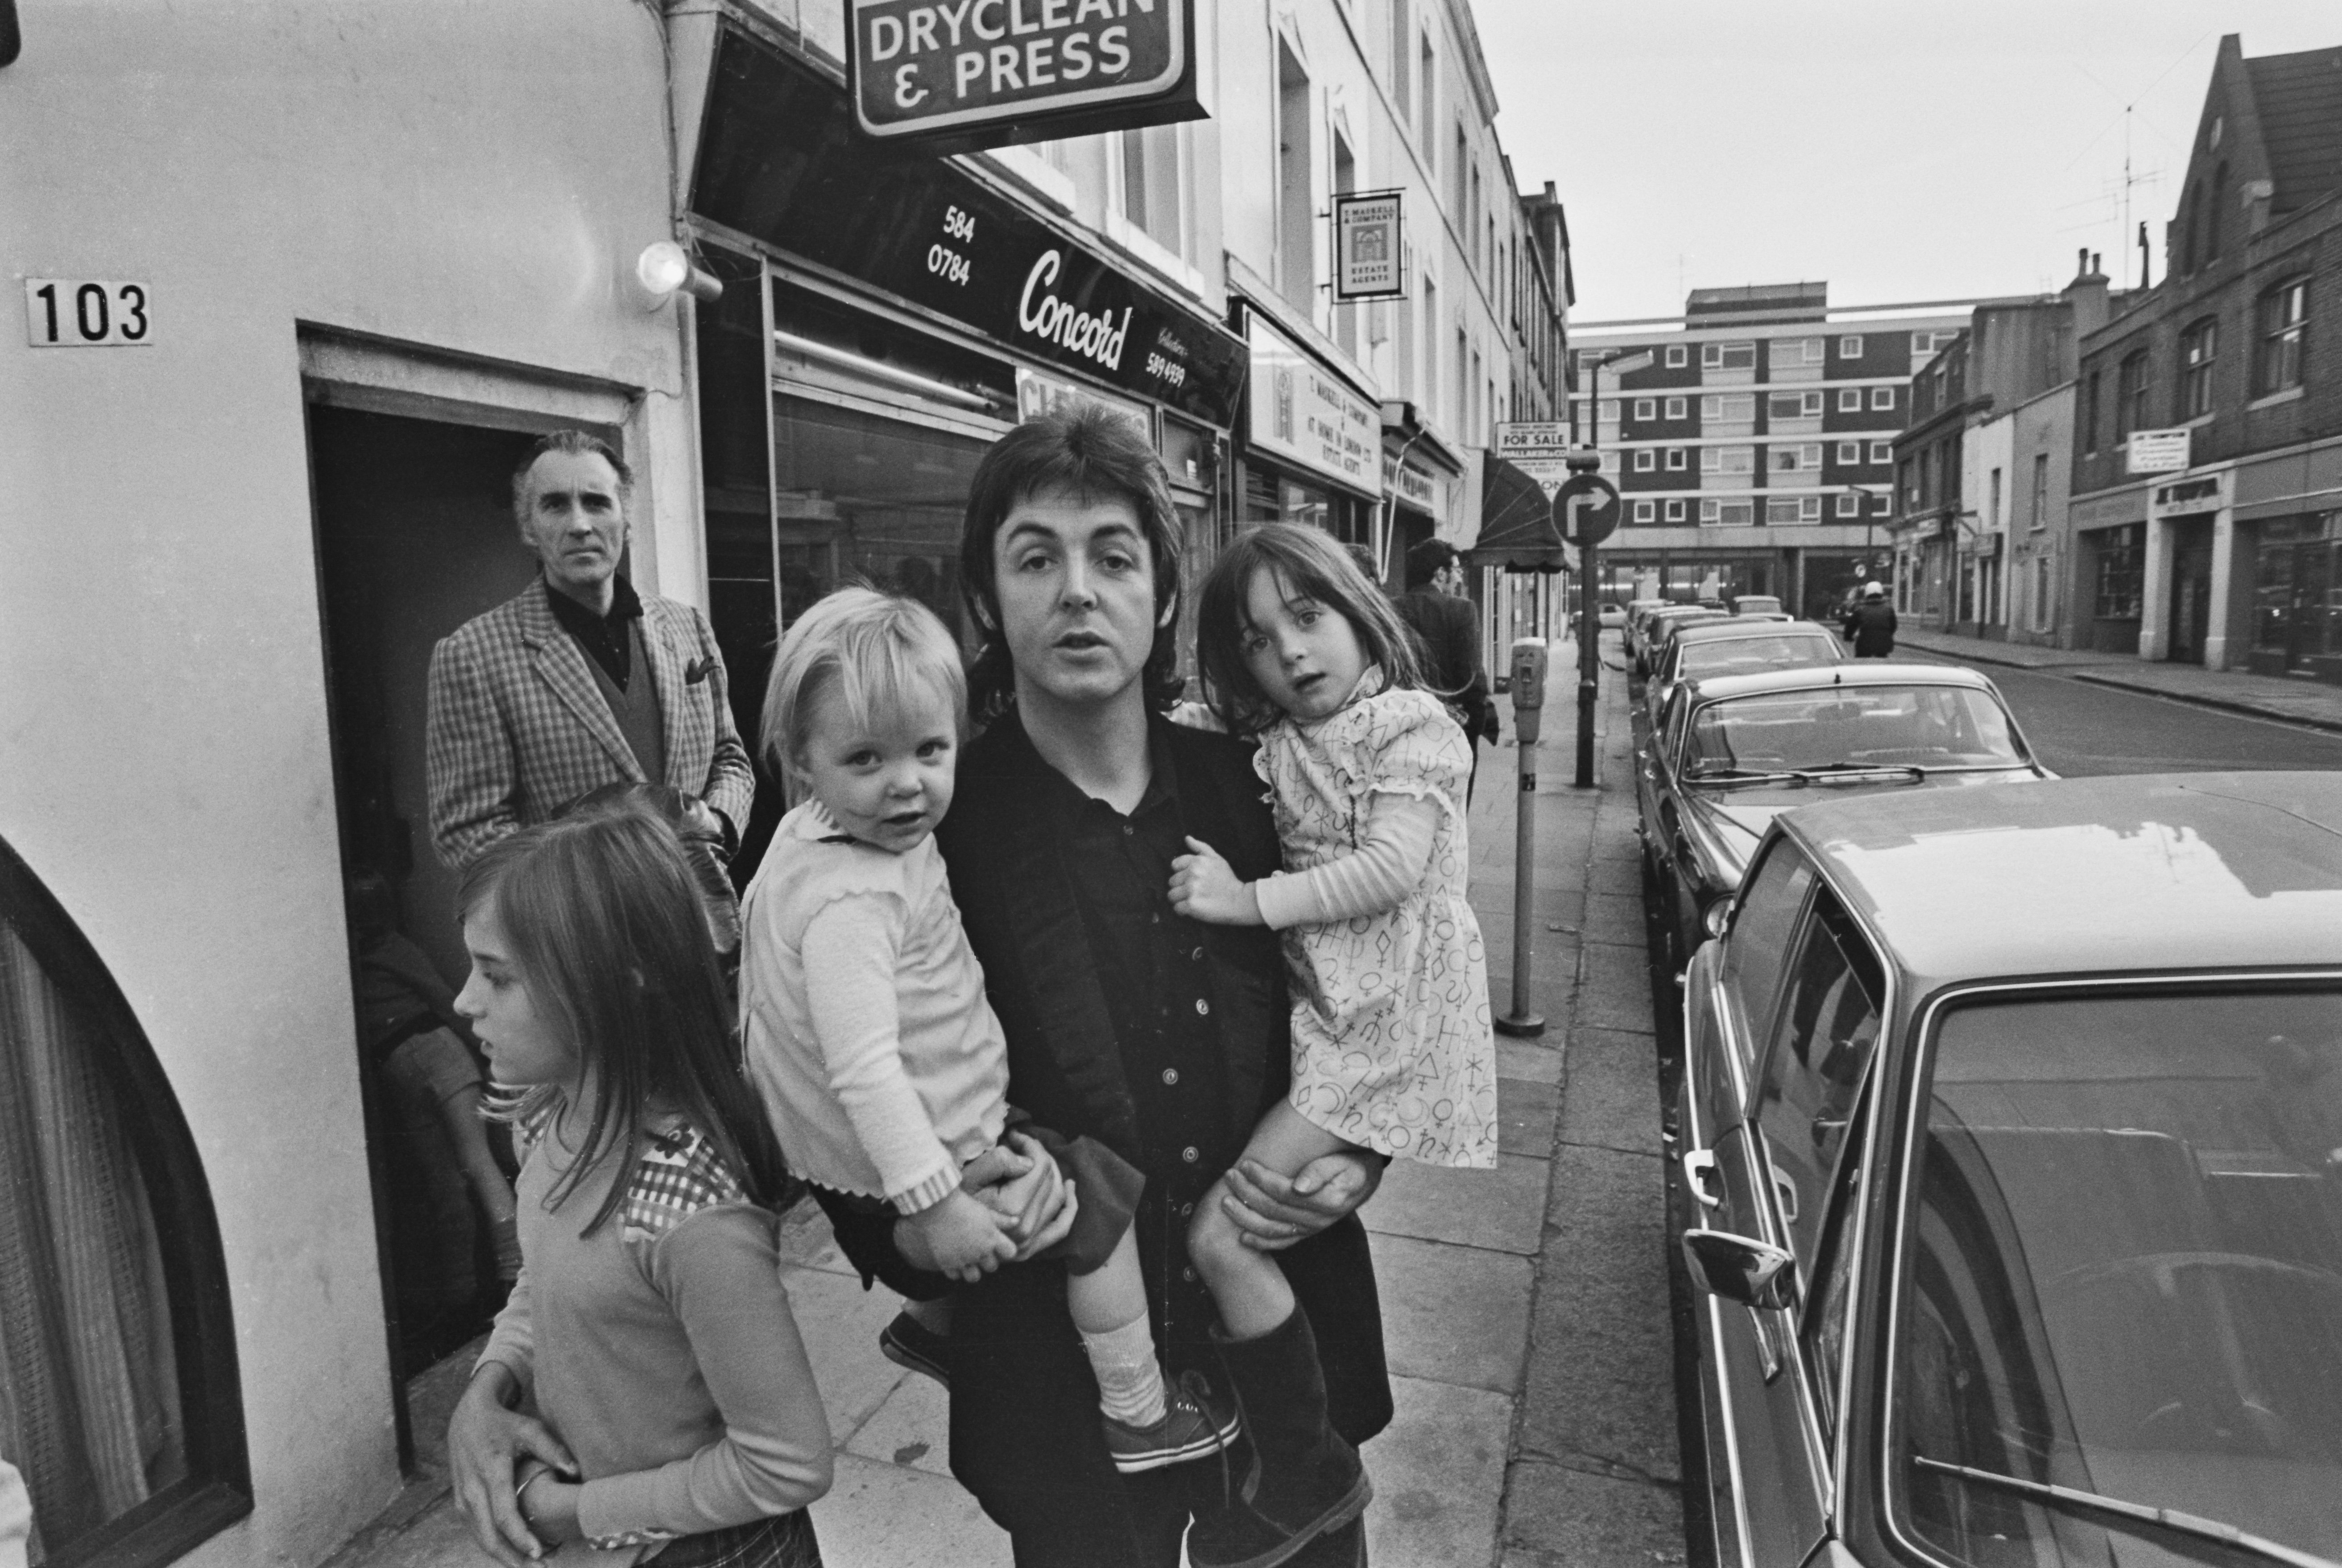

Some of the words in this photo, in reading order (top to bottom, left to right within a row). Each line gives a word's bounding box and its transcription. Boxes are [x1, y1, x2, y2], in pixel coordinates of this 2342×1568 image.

[894, 63, 929, 108] &
[956, 25, 1130, 98] PRESS
[943, 205, 975, 243] 584
[1352, 213, 1393, 223] COMPANY
[928, 243, 970, 286] 0784
[1352, 265, 1388, 275] ESTATE
[1352, 274, 1388, 284] AGENTS
[37, 283, 147, 342] 103
[1019, 249, 1133, 371] Concord
[1146, 352, 1165, 377] 589
[1164, 362, 1185, 387] 4939
[1504, 435, 1528, 445] FOR
[1534, 434, 1564, 445] SALE
